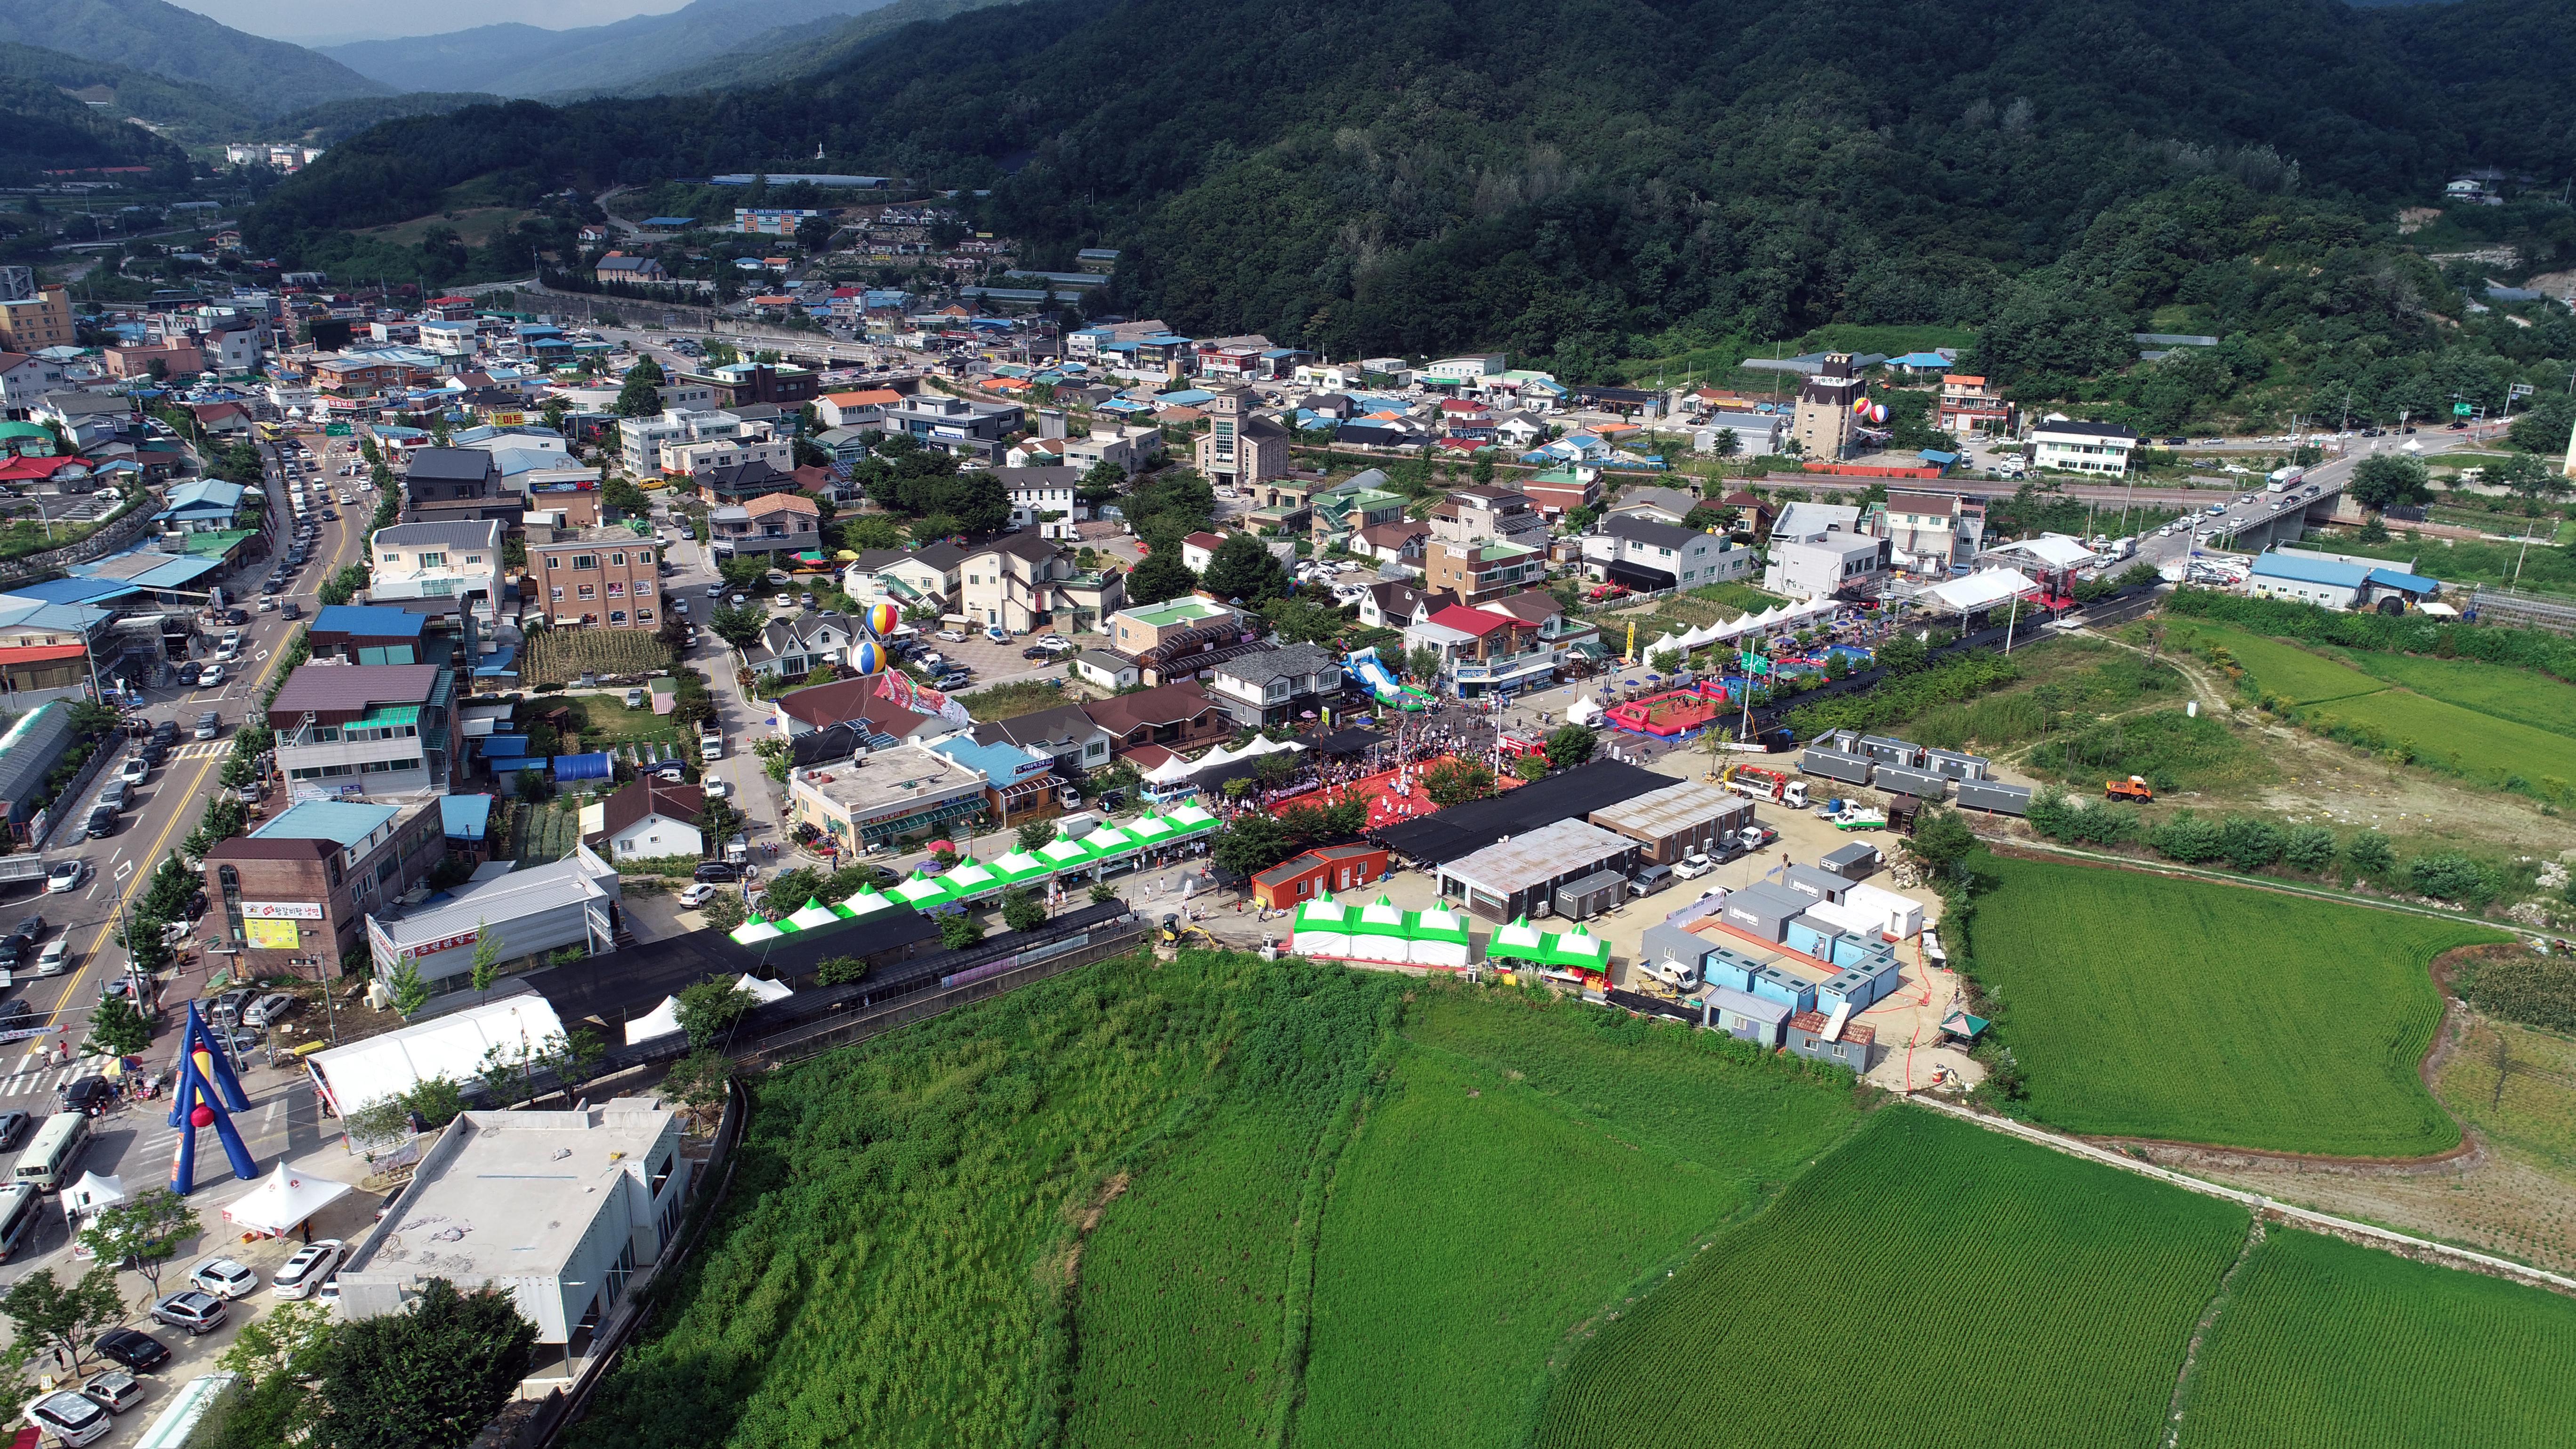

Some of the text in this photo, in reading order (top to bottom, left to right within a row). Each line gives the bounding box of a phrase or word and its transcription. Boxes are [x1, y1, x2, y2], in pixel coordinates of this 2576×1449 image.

[1825, 355, 1848, 364] 산수장
[503, 414, 523, 425] 마트
[275, 907, 303, 916] 왕갈비탕
[305, 907, 320, 916] 냉면
